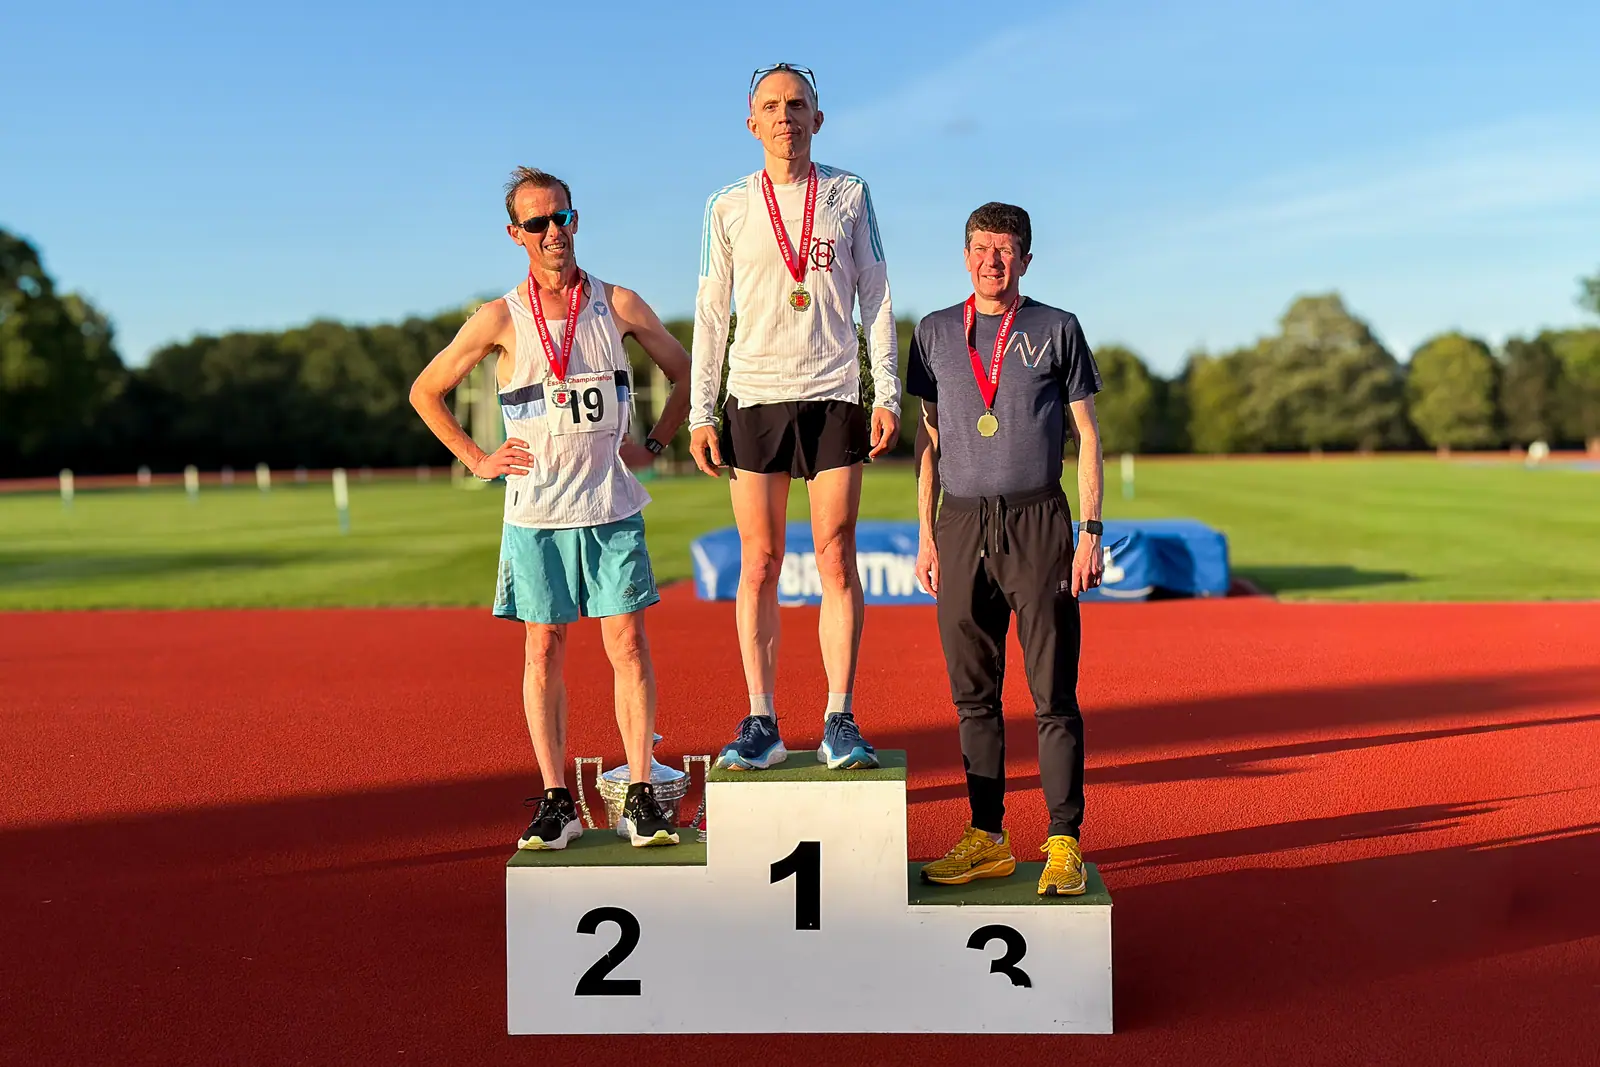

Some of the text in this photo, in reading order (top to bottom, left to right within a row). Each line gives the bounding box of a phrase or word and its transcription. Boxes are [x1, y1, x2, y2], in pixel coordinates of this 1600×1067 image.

[772, 216, 782, 240] COUNTY
[780, 240, 790, 262] ESSEX
[537, 316, 547, 340] COUNTY
[567, 311, 576, 336] COUNTY
[545, 342, 554, 361] ESSEX
[994, 338, 1004, 362] COUNTY
[567, 374, 612, 384] Championships
[570, 387, 605, 424] 19
[770, 840, 822, 931] 1
[574, 906, 642, 998] 2
[966, 924, 1033, 990] 3
